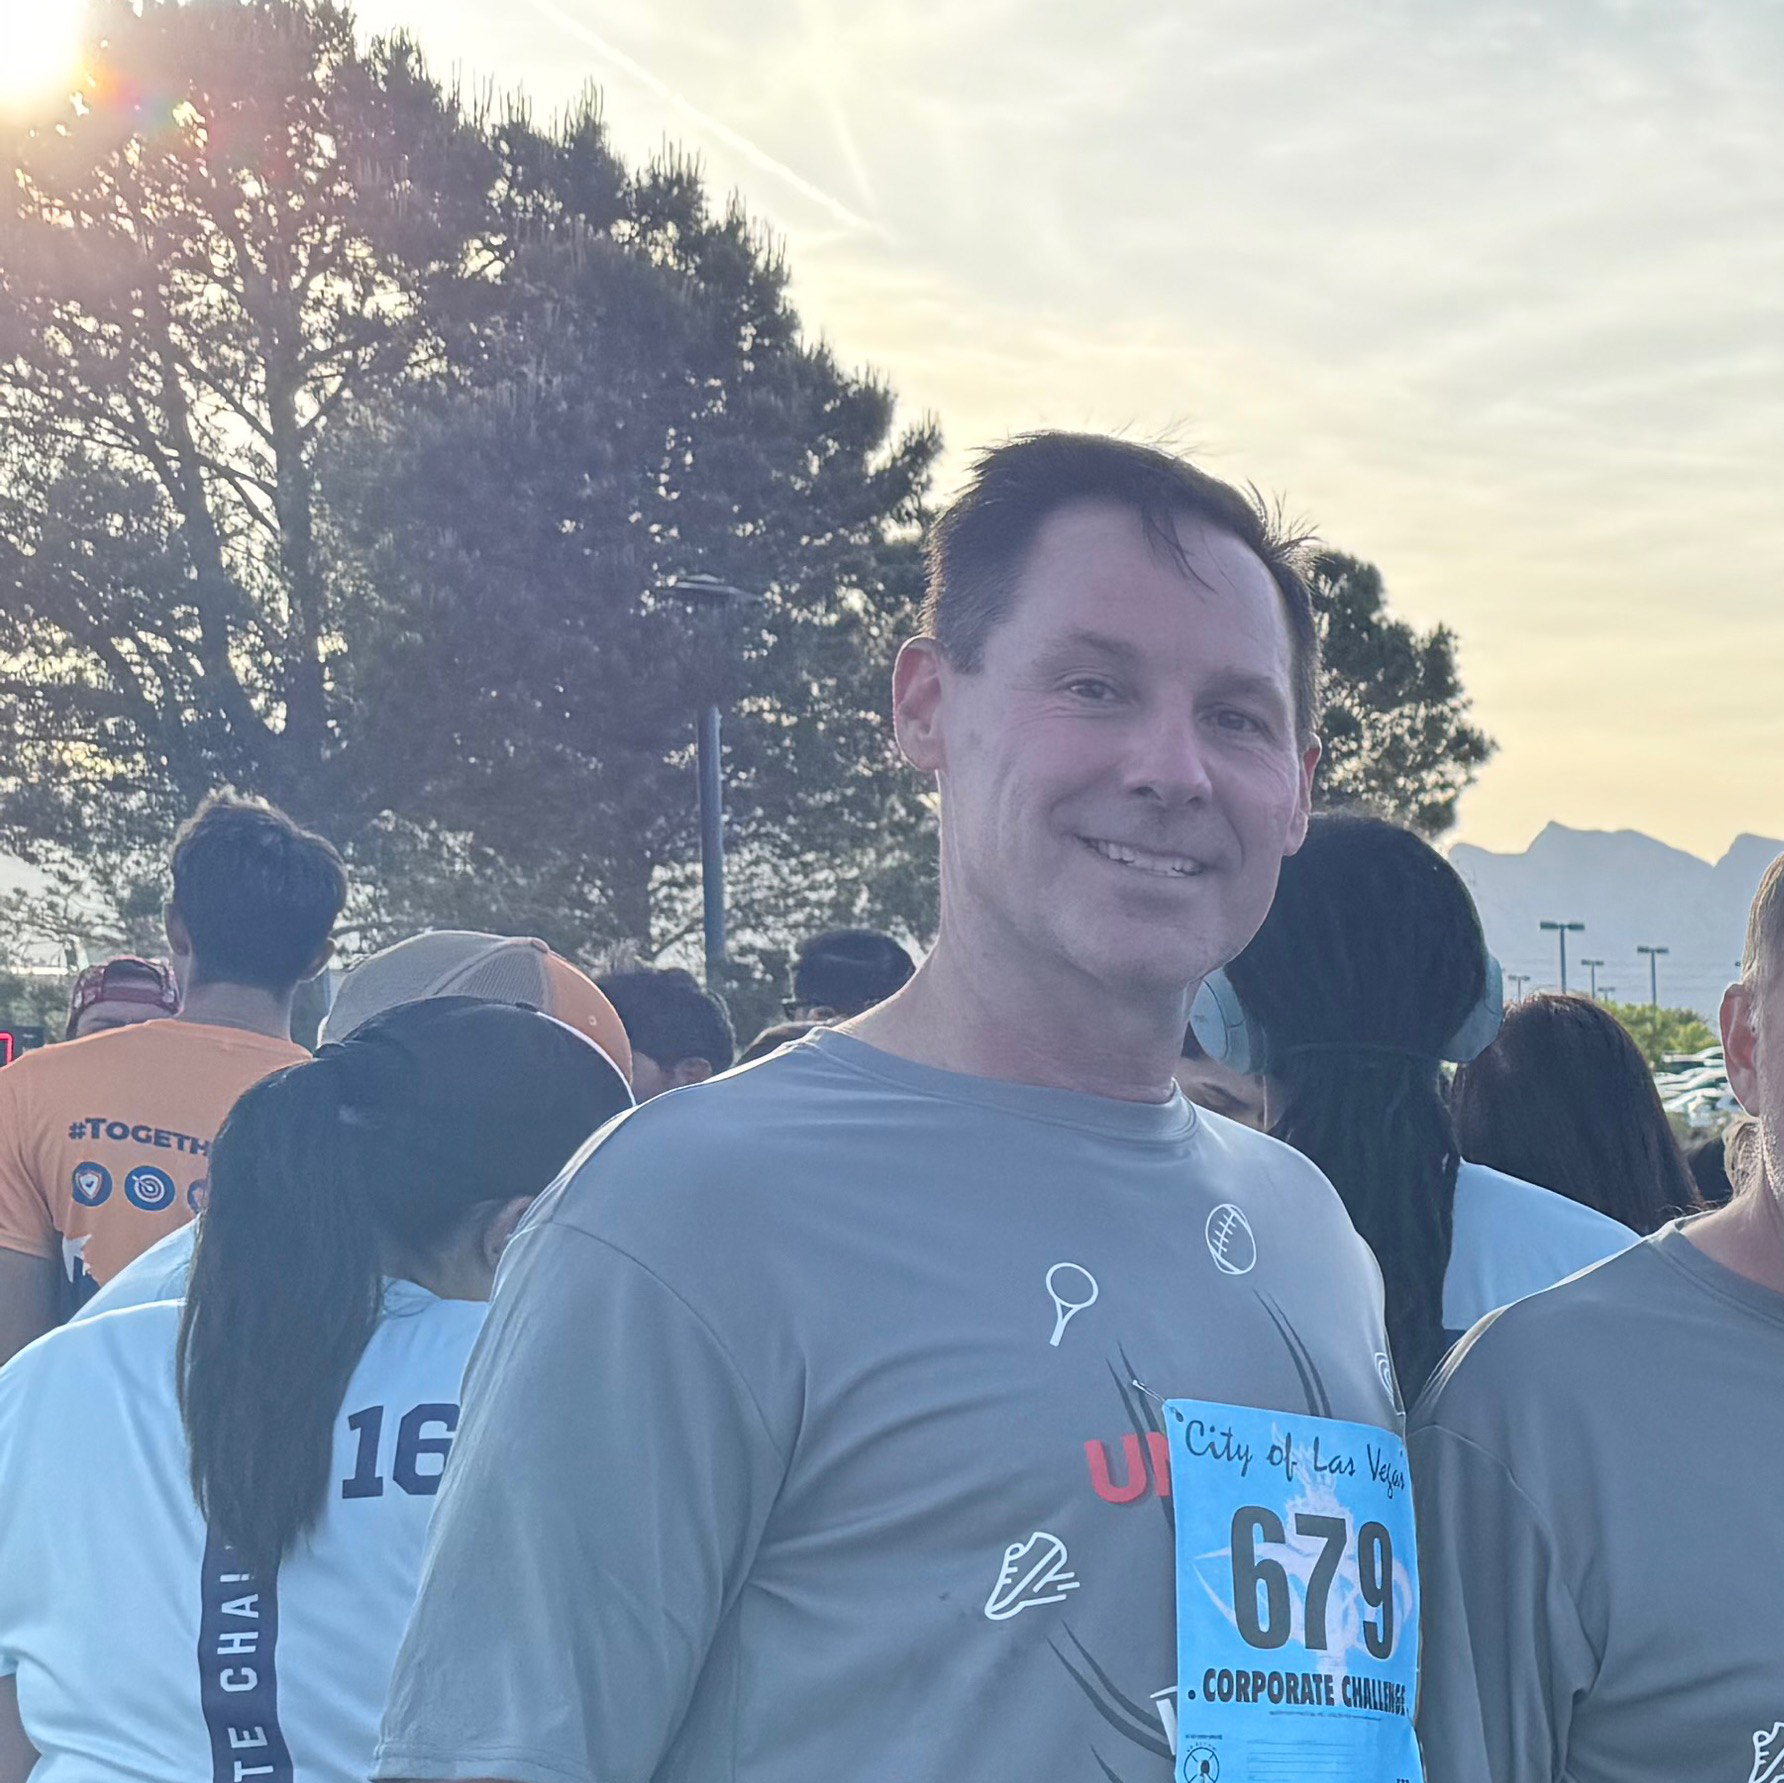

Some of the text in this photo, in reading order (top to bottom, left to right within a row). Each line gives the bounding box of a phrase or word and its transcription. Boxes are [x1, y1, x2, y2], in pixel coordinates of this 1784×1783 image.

[341, 1402, 460, 1499] 16
[1186, 1419, 1252, 1476] City
[1267, 1432, 1298, 1481] of
[1313, 1437, 1356, 1476] Las
[1230, 1504, 1394, 1661] 679
[1203, 1668, 1406, 1716] CORPORATE CHALLENGE
